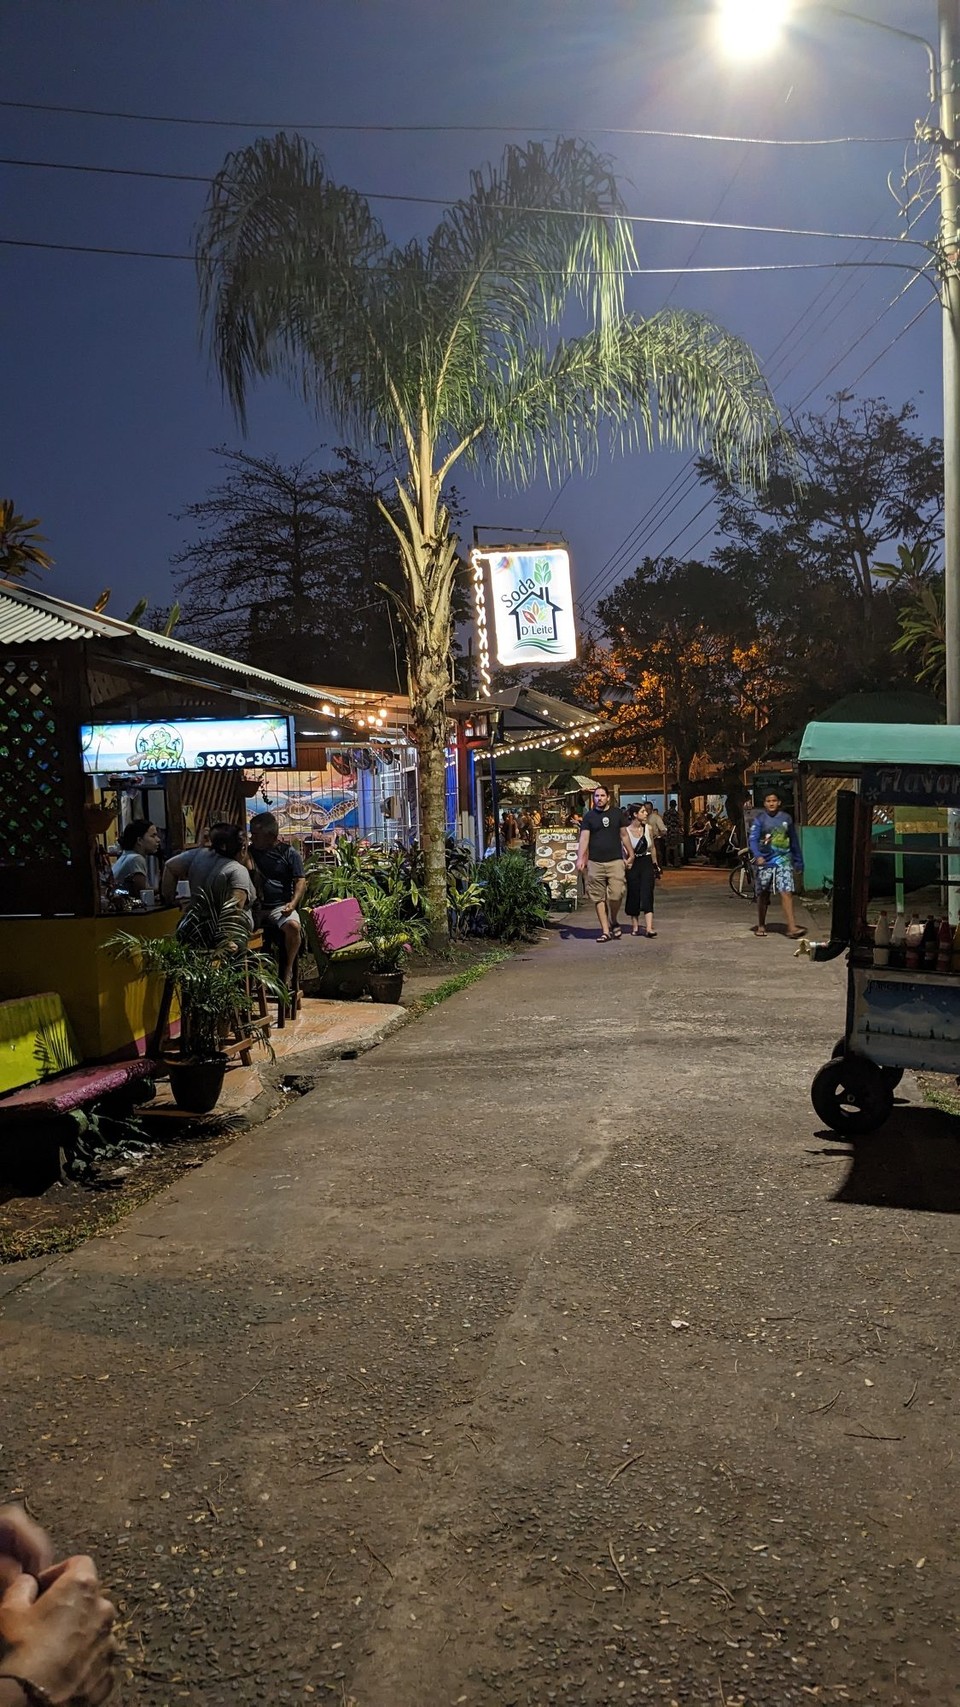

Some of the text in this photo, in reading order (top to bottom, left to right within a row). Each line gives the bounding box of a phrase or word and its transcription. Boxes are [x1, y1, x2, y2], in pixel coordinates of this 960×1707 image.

[500, 577, 536, 608] Soda
[139, 757, 186, 770] PAOLA
[206, 751, 289, 768] 8976-3615
